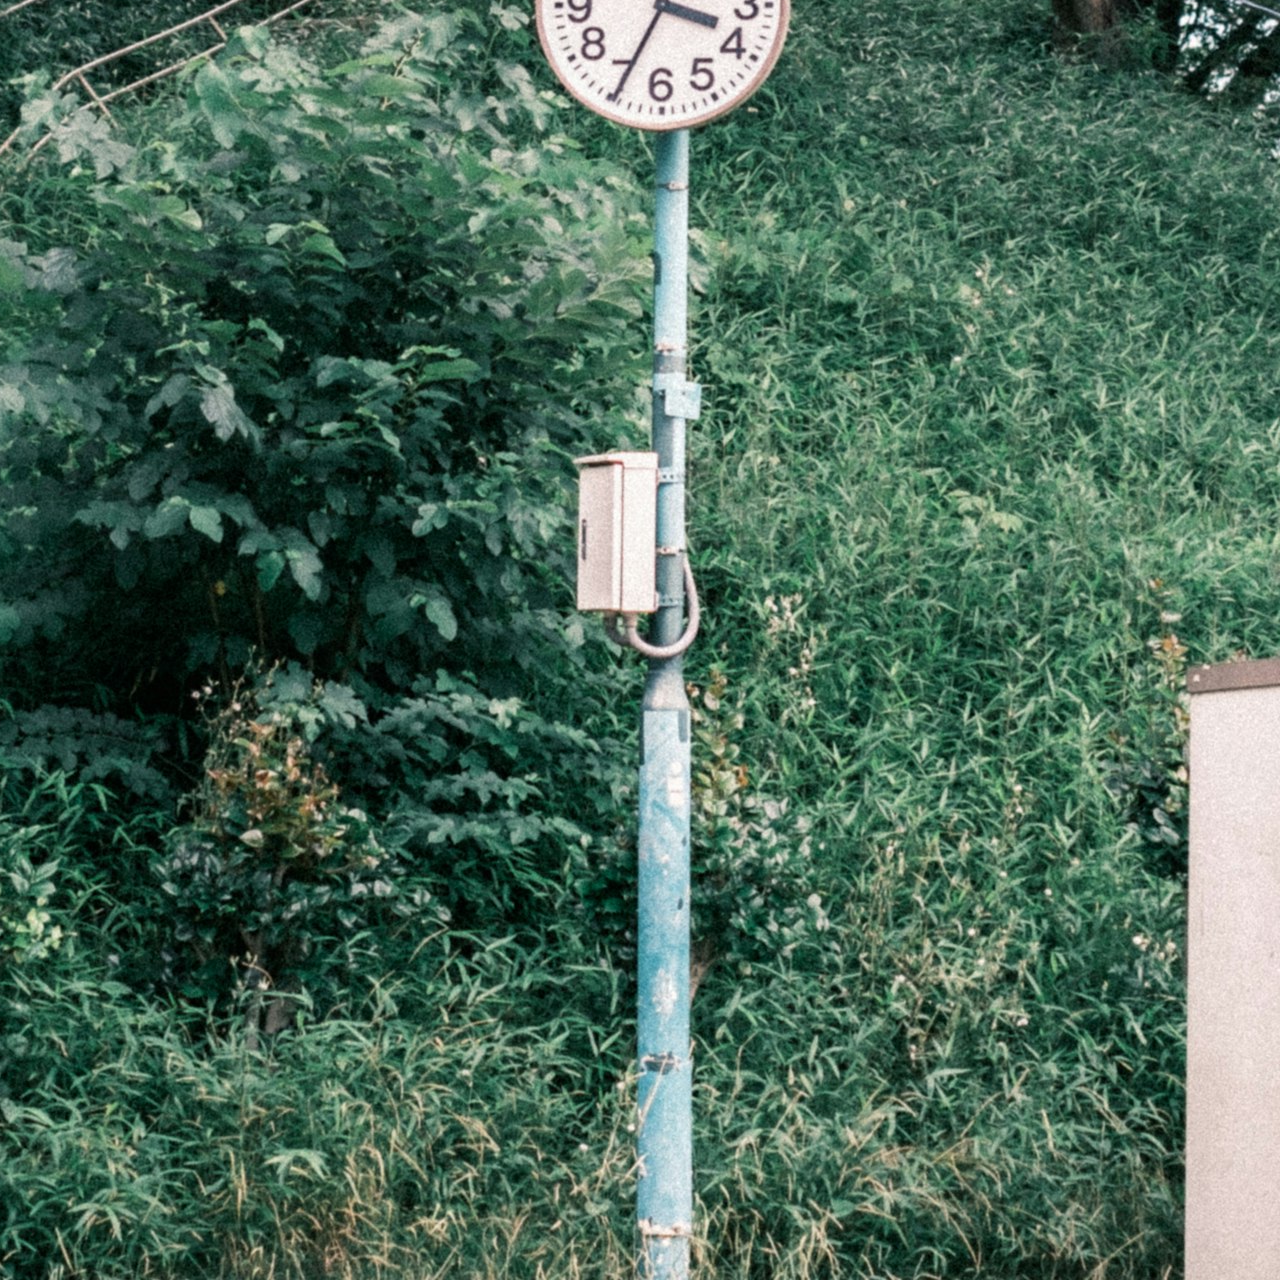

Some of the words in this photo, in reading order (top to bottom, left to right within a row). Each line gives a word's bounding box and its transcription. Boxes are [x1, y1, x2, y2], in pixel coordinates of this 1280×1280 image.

[580, 27, 606, 61] 8
[720, 27, 747, 60] 4
[648, 68, 673, 102] 6
[689, 57, 715, 91] 5
